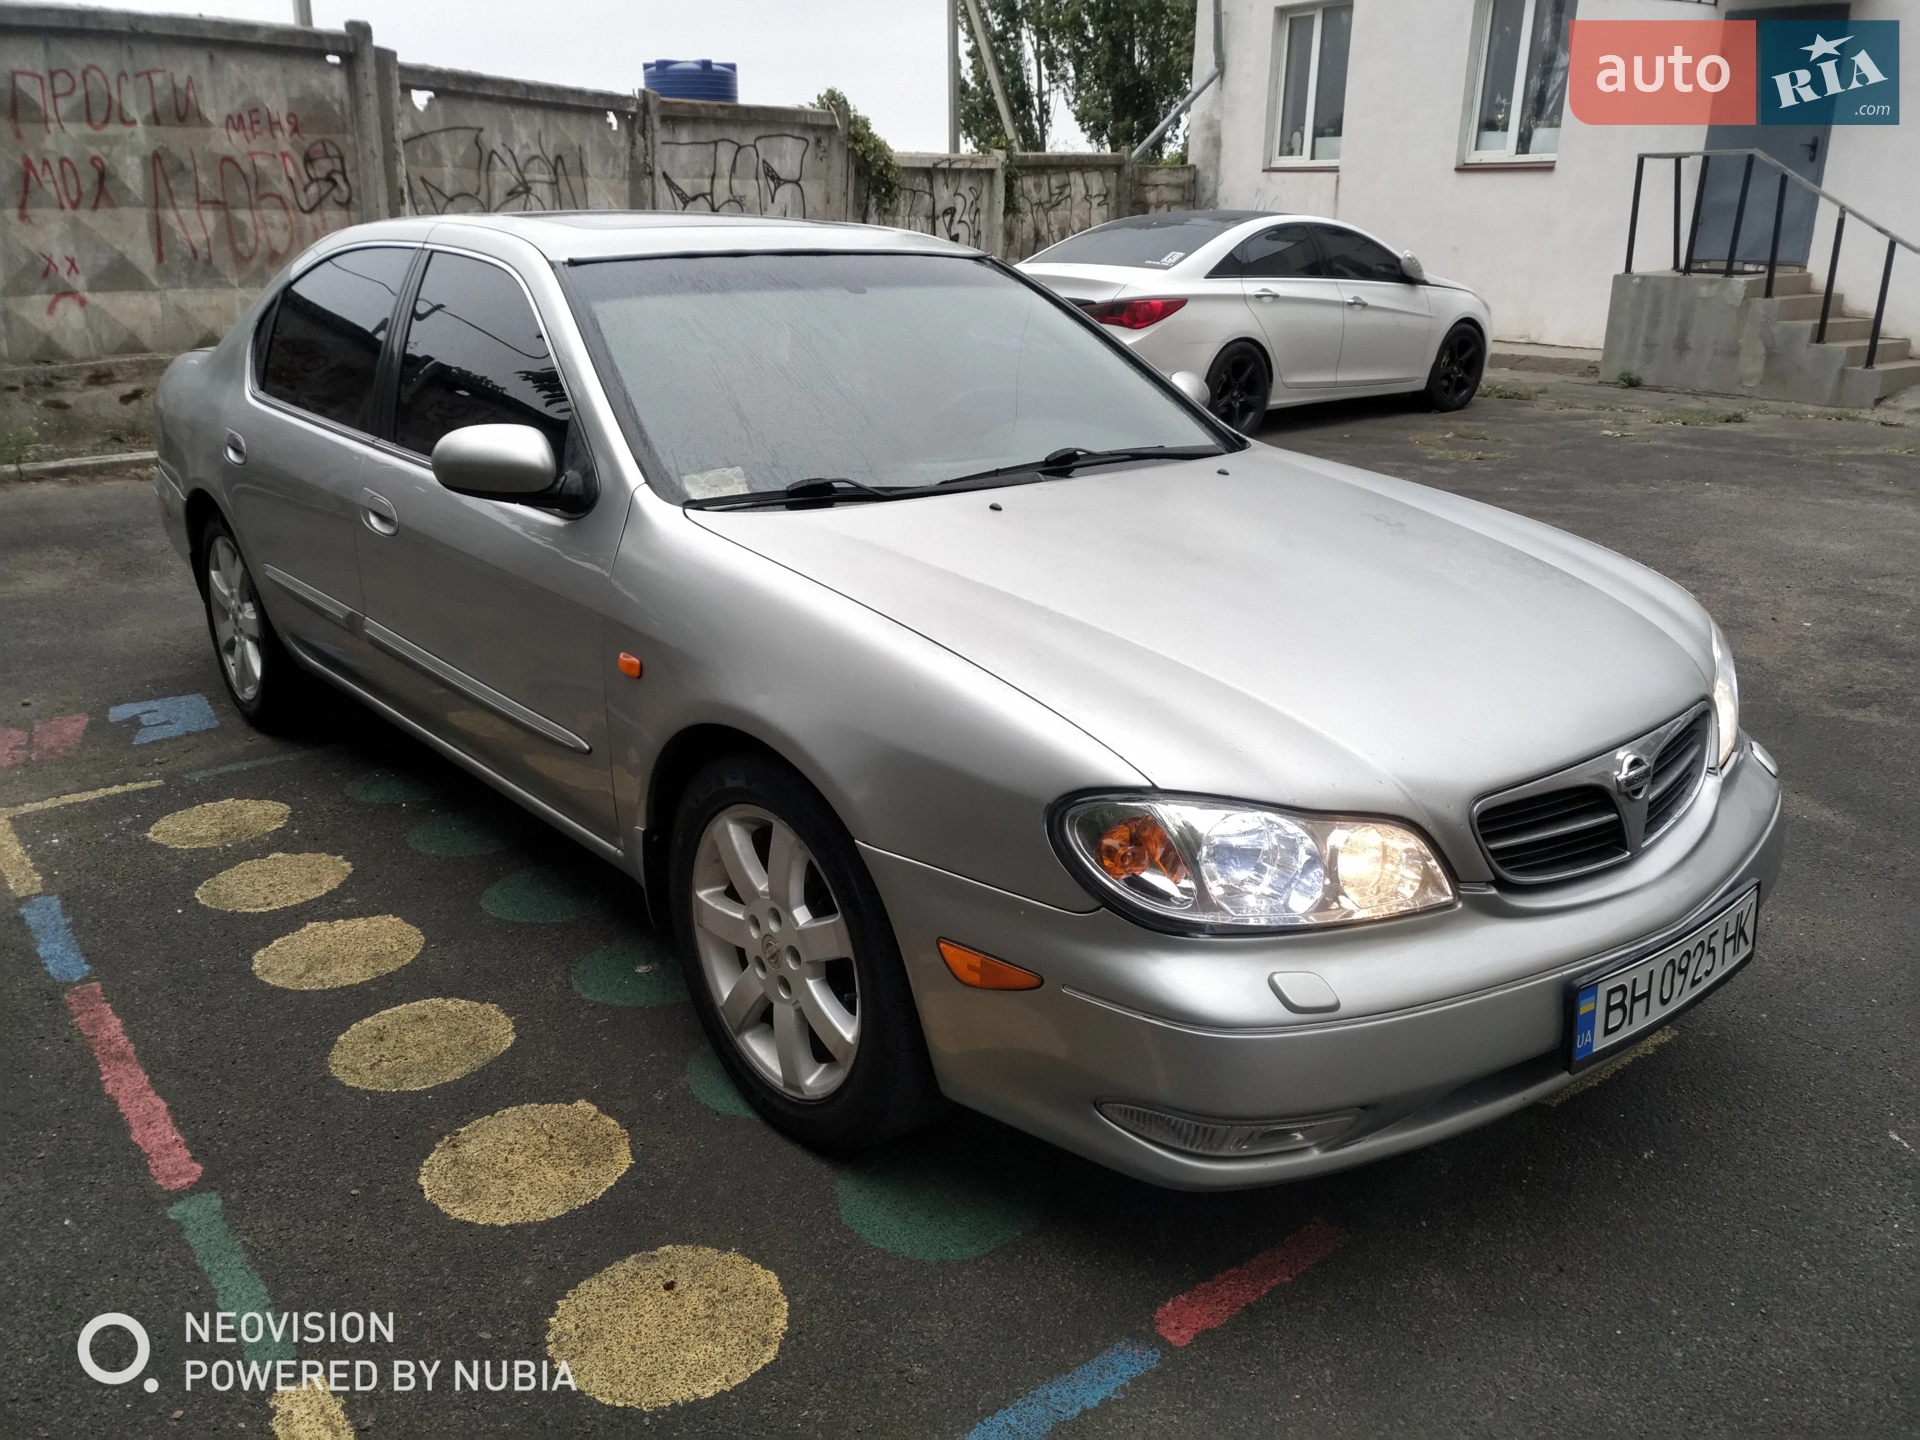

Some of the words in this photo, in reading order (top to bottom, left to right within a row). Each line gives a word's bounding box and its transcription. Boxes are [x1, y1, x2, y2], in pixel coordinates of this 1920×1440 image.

[9, 64, 203, 141] ПРОСТИ
[225, 107, 306, 143] МЕНЯ
[18, 153, 117, 226] МОЯ
[1603, 968, 1654, 1037] BH
[1659, 928, 1719, 1006] 0925
[1721, 900, 1753, 966] HK
[1577, 1029, 1592, 1048] UA
